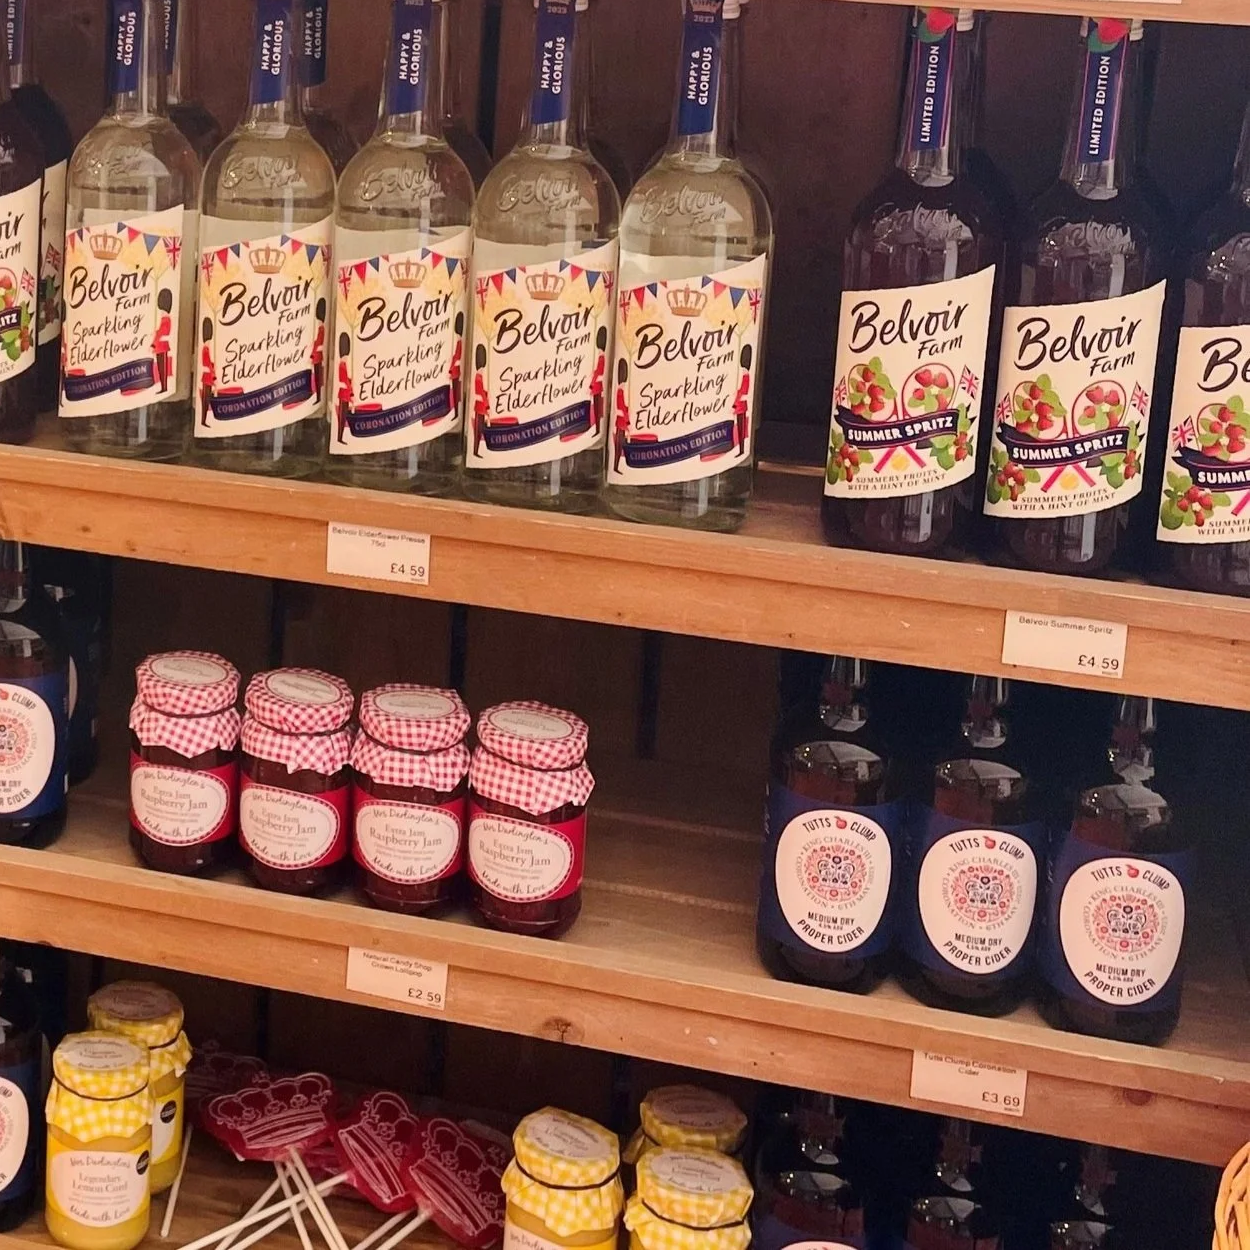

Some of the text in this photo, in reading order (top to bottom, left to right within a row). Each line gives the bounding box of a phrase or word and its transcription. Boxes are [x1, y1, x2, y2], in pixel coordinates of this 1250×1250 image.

[261, 33, 271, 70] HAPPY
[271, 19, 284, 75] GLORIOUS
[399, 41, 409, 80] HAPPY
[410, 28, 423, 85] GLORIOUS
[541, 49, 552, 89] HAPPY
[551, 36, 566, 95] GLORIOUS
[687, 59, 699, 100] HAPPY
[699, 46, 713, 106] GLORIOUS
[920, 46, 940, 142] LIMITED EDITION
[1089, 56, 1110, 155] LIMITED EDITION
[69, 264, 154, 309] Belvoir
[115, 292, 151, 312] Farm
[219, 275, 314, 326] Belvoir
[72, 313, 145, 346] Sparkling
[278, 304, 311, 326] Farm
[356, 290, 454, 342] Belvoir
[418, 318, 450, 341] Farm
[493, 302, 594, 355] Belvoir
[848, 299, 969, 354] Belvoir
[69, 332, 148, 366] Elderflower
[225, 326, 305, 364] Sparkling
[556, 331, 592, 355] Farm
[634, 320, 739, 370] Belvoir
[917, 335, 963, 360] Farm
[1014, 315, 1142, 371] Belvoir
[221, 345, 308, 385] Elderflower
[363, 340, 445, 380] Sparkling
[499, 354, 585, 393] Sparkling
[696, 348, 735, 373] Farm
[1089, 351, 1136, 377] Farm
[359, 359, 448, 401] Elderflower
[495, 375, 587, 415] Elderflower
[639, 371, 728, 410] Sparkling
[635, 393, 730, 431] Elderflower
[848, 416, 953, 441] SUMMER SPRITZ
[1012, 434, 1124, 460] SUMMER SPRITZ
[390, 562, 425, 577] £4.59
[1050, 620, 1086, 631] Summer
[1078, 654, 1119, 671] £4.59
[11, 693, 37, 710] CLUMP
[7, 788, 32, 806] CIDER
[369, 826, 442, 848] Raspberry Jam
[803, 817, 876, 841] TUTTS CLUMP
[479, 840, 551, 867] Raspberry Jam
[999, 840, 1025, 860] CLUMP
[1091, 866, 1170, 890] TUTTS CLUMP
[798, 919, 864, 944] PROPER CIDER
[808, 912, 838, 923] MEDIUM
[943, 940, 1012, 966] PROPER CIDER
[1084, 971, 1156, 997] PROPER CIDER
[1096, 963, 1146, 977] MEDIUM DRY
[408, 988, 441, 1003] £2.59
[982, 1091, 1020, 1107] £3.69
